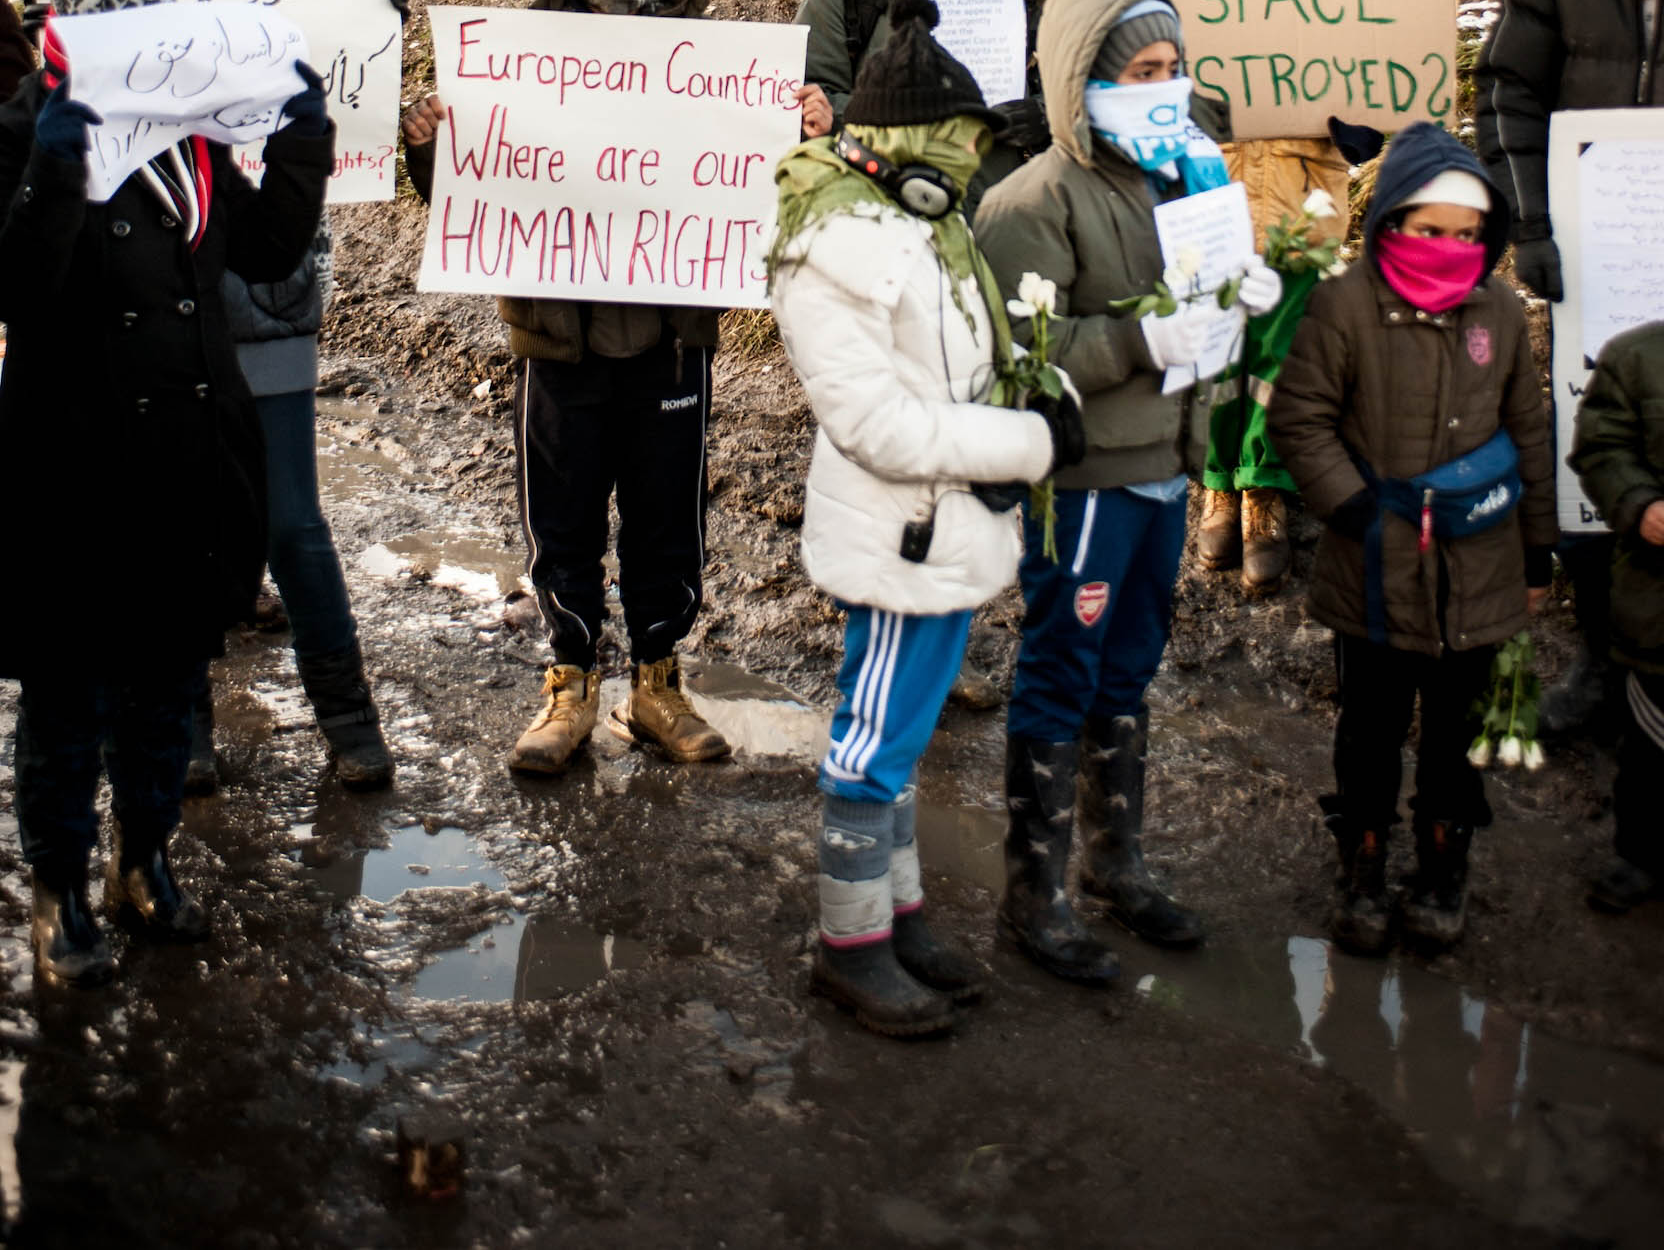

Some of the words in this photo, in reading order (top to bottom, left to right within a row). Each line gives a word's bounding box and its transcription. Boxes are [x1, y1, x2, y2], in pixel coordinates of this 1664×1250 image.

[457, 17, 648, 105] European
[666, 40, 803, 111] Countries
[1184, 52, 1453, 127] STROYED?
[330, 144, 394, 180] ghts?
[448, 103, 566, 183] Where
[596, 145, 660, 187] are
[693, 149, 765, 189] our
[441, 196, 613, 286] HUMAN
